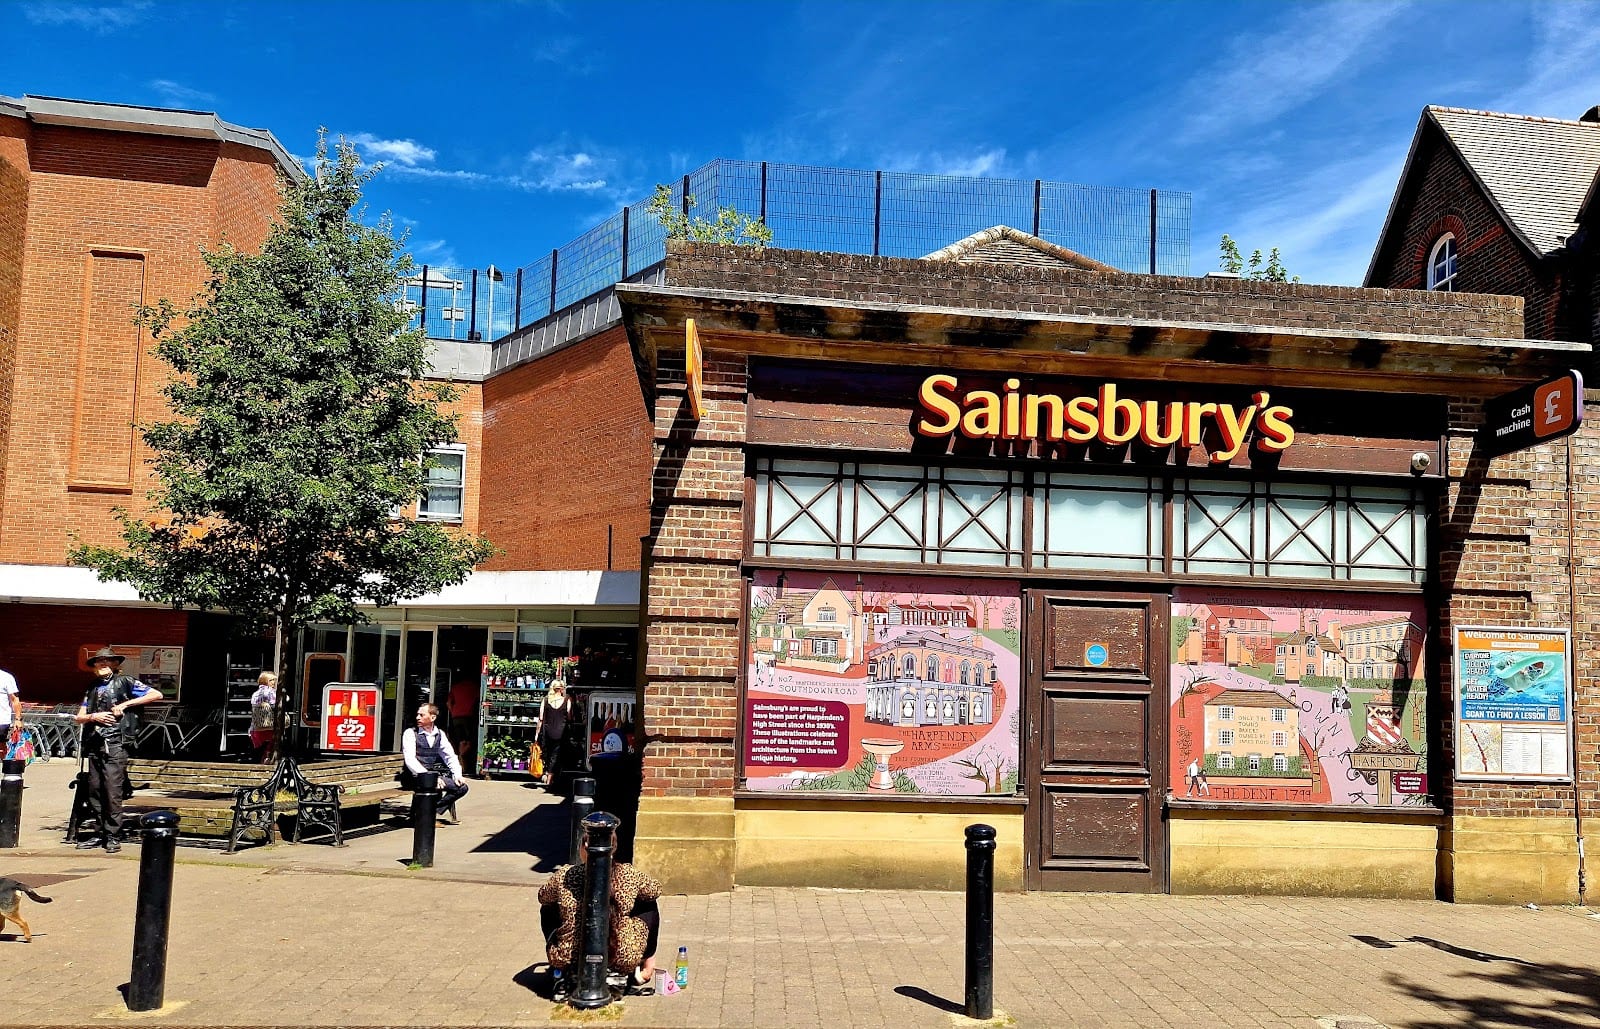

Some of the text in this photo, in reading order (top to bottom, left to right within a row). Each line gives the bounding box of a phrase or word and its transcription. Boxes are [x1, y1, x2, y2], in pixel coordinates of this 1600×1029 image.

[1511, 404, 1530, 418] Cash
[918, 374, 1295, 463] Sainsbury's
[1496, 419, 1531, 437] machine
[1464, 631, 1505, 640] Welcome
[1507, 632, 1516, 640] to
[753, 704, 788, 712] Sainsbury's
[806, 714, 844, 722] Harpenden's
[1466, 710, 1484, 718] SCAN
[1521, 712, 1546, 720] LESSON
[336, 724, 366, 737] £22
[911, 730, 978, 742] HARPENDEN
[911, 742, 940, 750] ARMS
[752, 755, 774, 764] unique
[1353, 755, 1416, 768] HARPENDEN
[1213, 788, 1239, 800] THE
[1242, 788, 1278, 800] DENE
